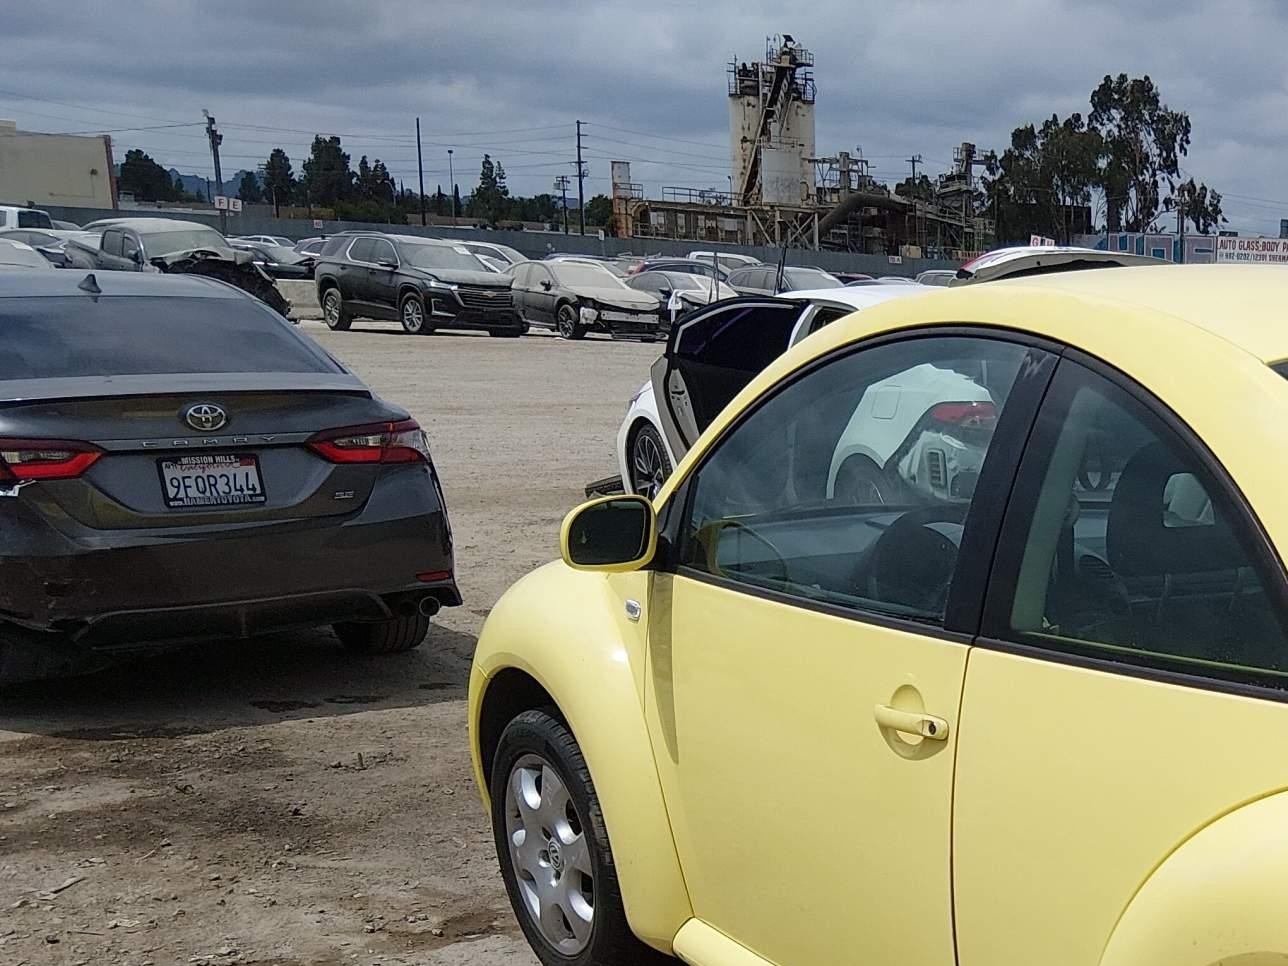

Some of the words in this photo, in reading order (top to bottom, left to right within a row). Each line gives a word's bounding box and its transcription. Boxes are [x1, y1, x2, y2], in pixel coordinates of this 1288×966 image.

[1219, 239, 1237, 250] AUTO
[142, 435, 275, 448] CAMRY
[180, 455, 214, 465] MISSION
[214, 454, 236, 464] HILLS
[169, 471, 258, 500] 9FQR344
[333, 490, 355, 499] SE
